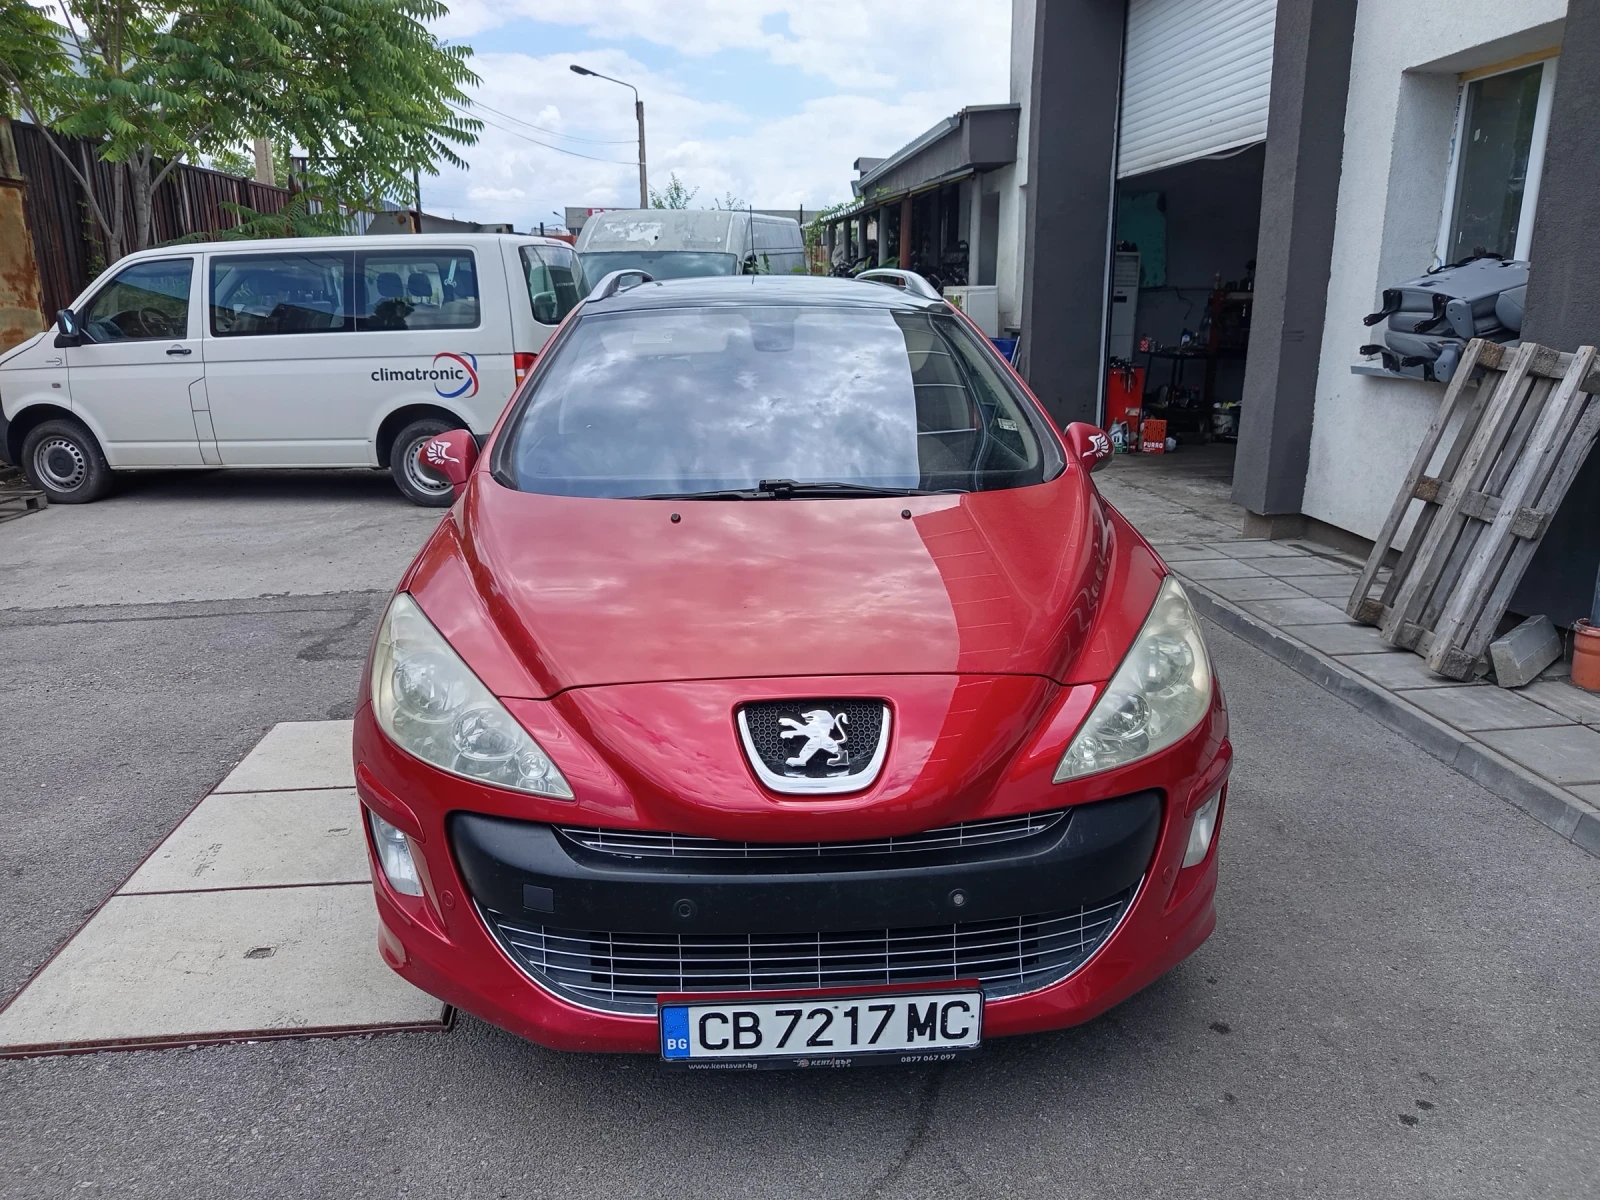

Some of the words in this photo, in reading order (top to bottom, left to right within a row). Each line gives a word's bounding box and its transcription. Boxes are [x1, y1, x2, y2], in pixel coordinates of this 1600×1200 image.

[371, 367, 464, 381] climatronic
[699, 1011, 762, 1050] CB
[775, 1004, 895, 1048] 7217
[907, 1000, 970, 1042] MC
[667, 1038, 687, 1050] BG
[688, 1062, 758, 1070] www.kentavar.bg
